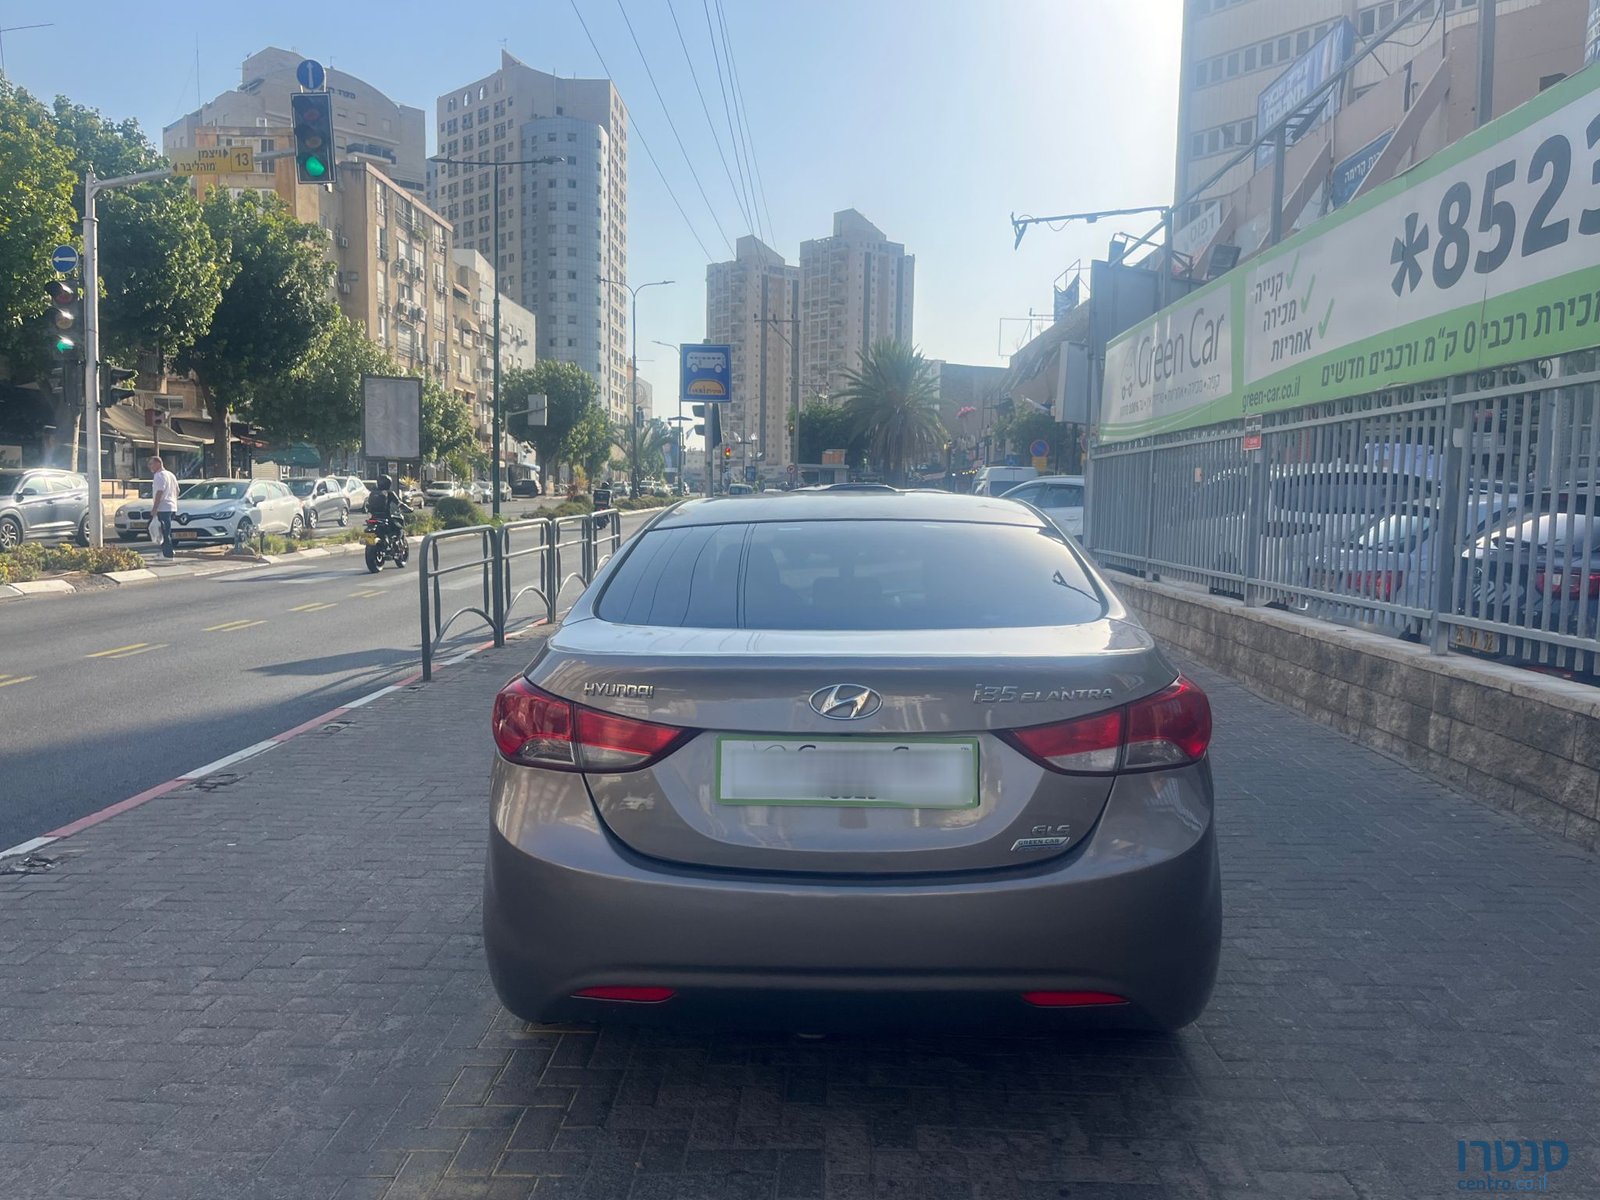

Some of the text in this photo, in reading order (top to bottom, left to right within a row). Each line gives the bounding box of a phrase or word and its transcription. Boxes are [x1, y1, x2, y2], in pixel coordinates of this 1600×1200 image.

[180, 160, 217, 172] מוהליבר
[198, 149, 222, 161] ויצמן
[235, 153, 250, 166] 13
[1254, 271, 1284, 304] קנייה
[1263, 299, 1297, 332] מכירה
[1480, 312, 1528, 350] רכבי
[1138, 307, 1225, 388] Green Car
[1270, 327, 1313, 362] אחריות
[1463, 320, 1477, 354] 0
[1321, 355, 1365, 387] חדשים
[1369, 341, 1419, 376] ורכבים
[1241, 375, 1301, 413] green-car.co.il
[584, 682, 654, 699] HYUNDAI
[973, 683, 1113, 703] i35 ELANTRA
[1019, 839, 1044, 847] GREEN
[1031, 824, 1071, 837] GLS
